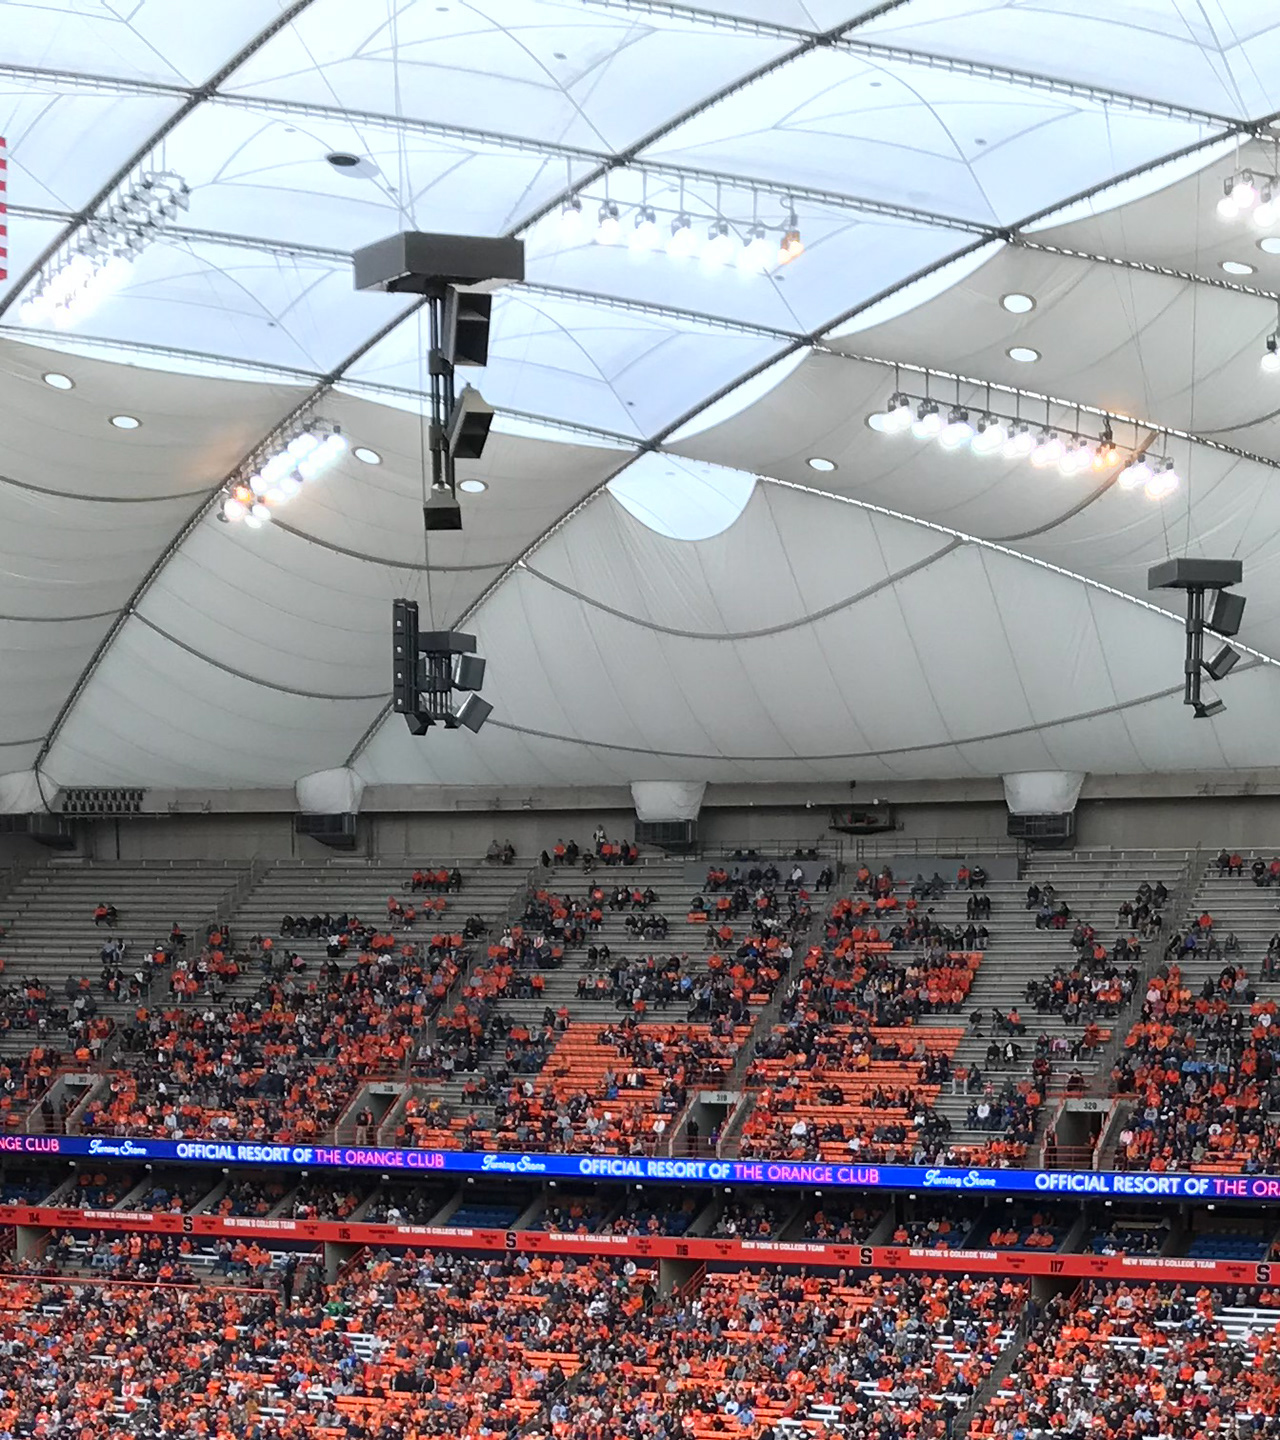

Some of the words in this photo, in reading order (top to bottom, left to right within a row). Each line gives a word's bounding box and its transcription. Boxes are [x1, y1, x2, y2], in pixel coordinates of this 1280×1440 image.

[25, 1137, 60, 1152] CLUB
[176, 1143, 235, 1160] OFFICIAL
[237, 1145, 290, 1162] RESORT
[293, 1147, 313, 1163] OF
[315, 1148, 342, 1164] THE
[345, 1150, 403, 1166] ORANGE
[407, 1152, 445, 1168] CLUB
[579, 1158, 645, 1177] OFFICIAL
[647, 1160, 705, 1179] RESORT
[708, 1162, 731, 1179] OF
[734, 1163, 763, 1181] THE
[767, 1165, 833, 1183] ORANGE
[837, 1167, 880, 1185] CLUB
[1034, 1173, 1110, 1193] OFFICIAL
[1112, 1175, 1182, 1196] RESORT
[1184, 1177, 1210, 1196] OF
[1213, 1178, 1248, 1197] THE
[859, 1247, 874, 1266] S
[1255, 1264, 1271, 1282] S
